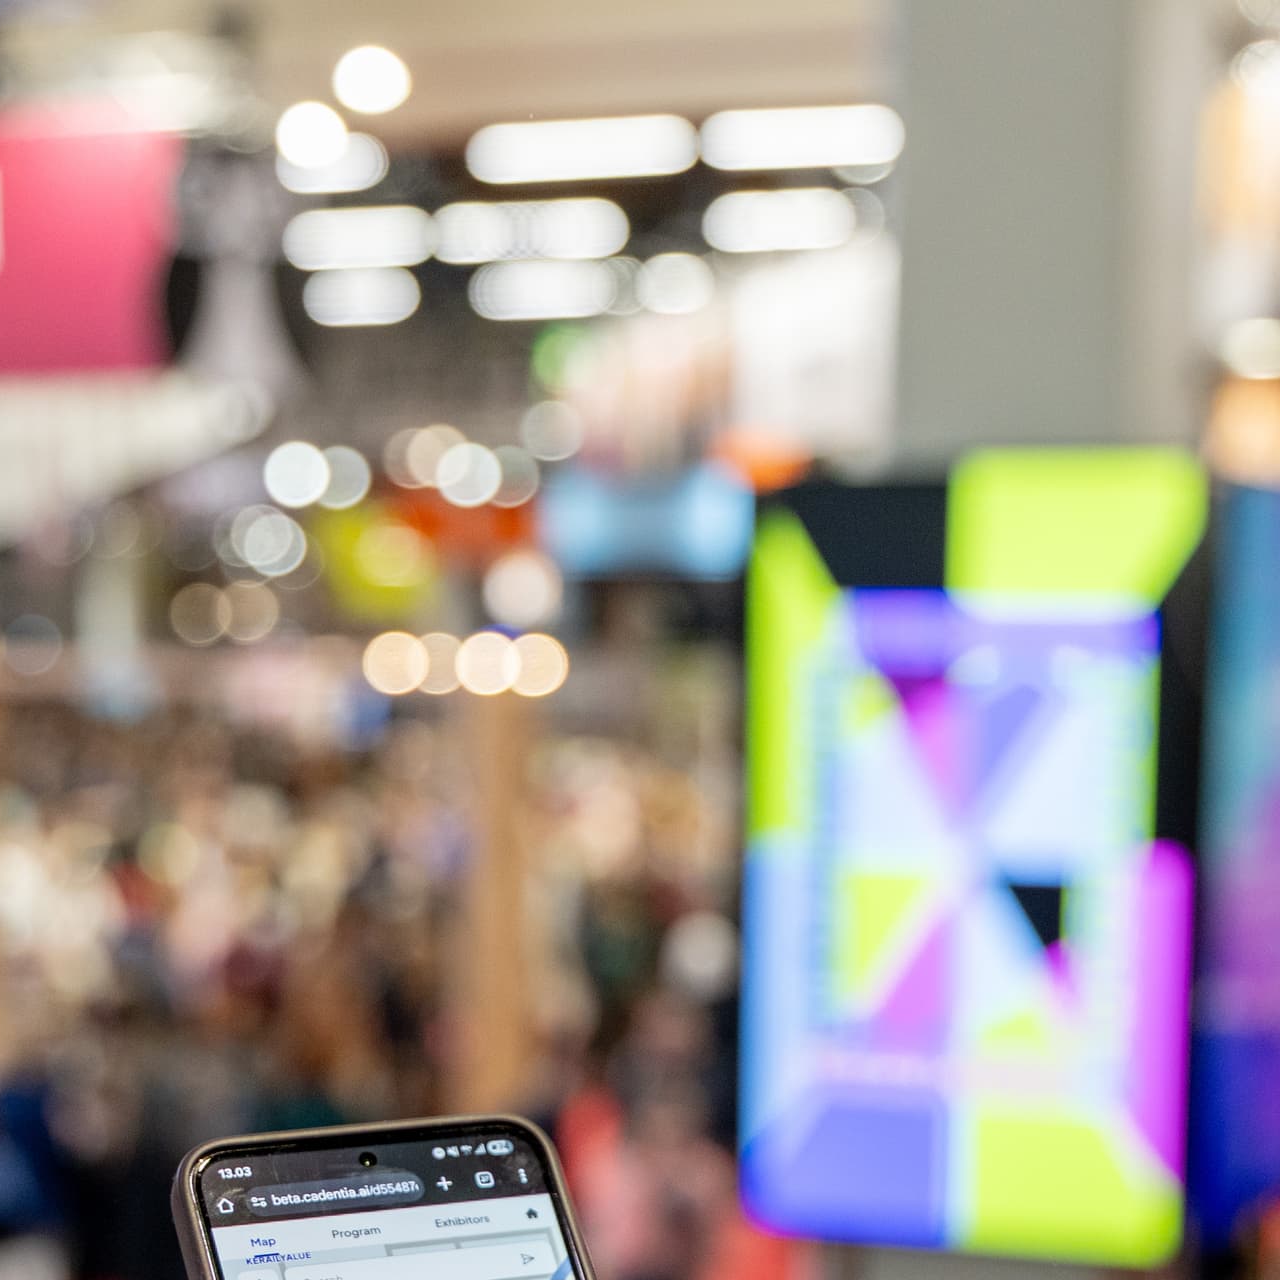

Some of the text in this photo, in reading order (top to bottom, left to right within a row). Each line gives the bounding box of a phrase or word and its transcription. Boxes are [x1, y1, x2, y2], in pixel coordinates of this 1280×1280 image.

[218, 1166, 252, 1179] 13.03
[435, 1214, 490, 1228] Exhibitors
[331, 1226, 381, 1240] Program
[250, 1237, 276, 1249] Map
